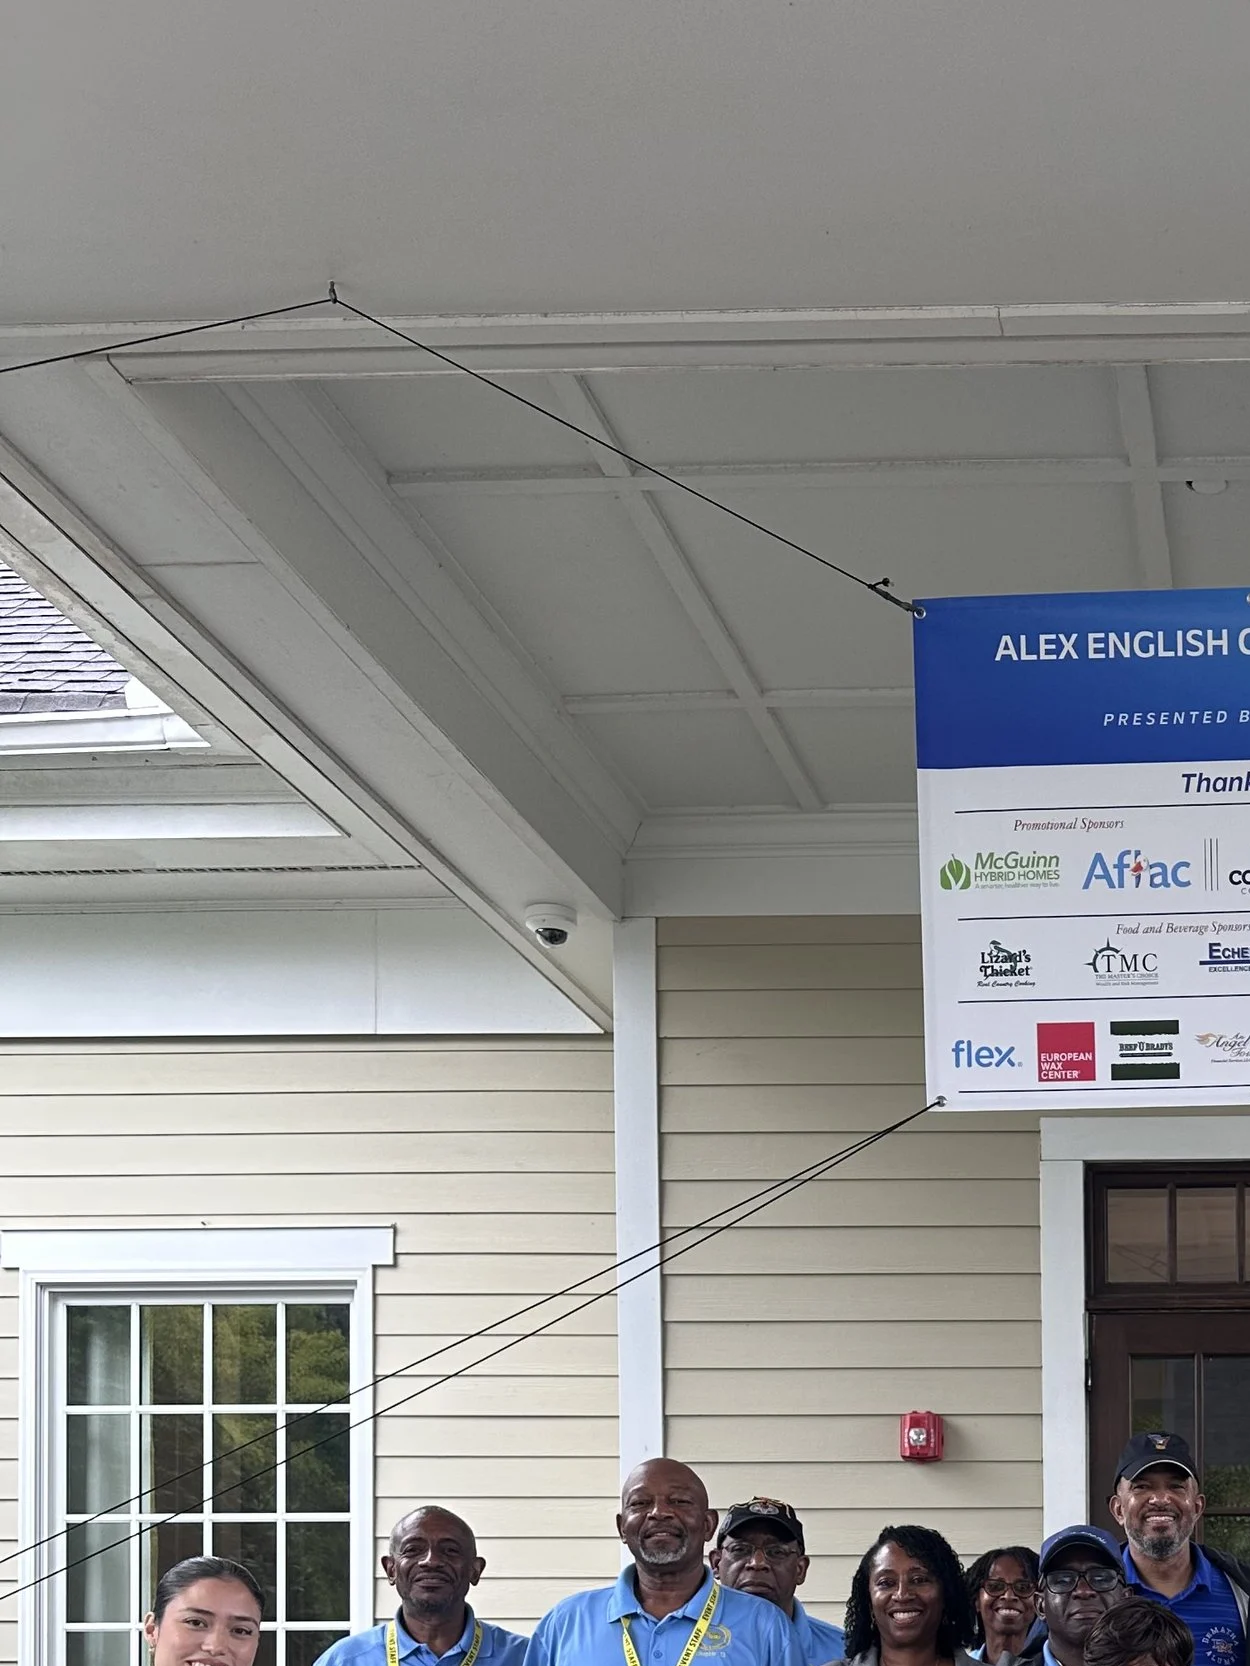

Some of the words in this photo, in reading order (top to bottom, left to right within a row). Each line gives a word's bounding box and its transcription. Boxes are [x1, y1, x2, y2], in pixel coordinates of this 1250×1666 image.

[994, 633, 1079, 661] ALEX
[1087, 628, 1229, 659] ENGLISH
[1103, 711, 1228, 726] PRESENTED
[1013, 818, 1077, 832] Promotional
[1079, 818, 1124, 832] Sponsors
[974, 850, 1060, 870] McGuinn
[974, 871, 1015, 882] HYBRID
[1018, 869, 1060, 881] HOMES
[1081, 849, 1192, 890] Aflac
[1116, 922, 1141, 935] Food
[1142, 922, 1163, 934] and
[1165, 922, 1209, 936] Beverage
[1211, 921, 1250, 935] Sponsors
[981, 949, 1031, 964] Lizard's
[1100, 953, 1158, 973] TMC
[979, 964, 1032, 979] Thicket
[1040, 1052, 1093, 1061] EUROPEAN
[1040, 1062, 1064, 1070] WAX
[1040, 1070, 1079, 1079] CENTER
[702, 1605, 712, 1621] EVENT
[690, 1628, 702, 1650] STAFF
